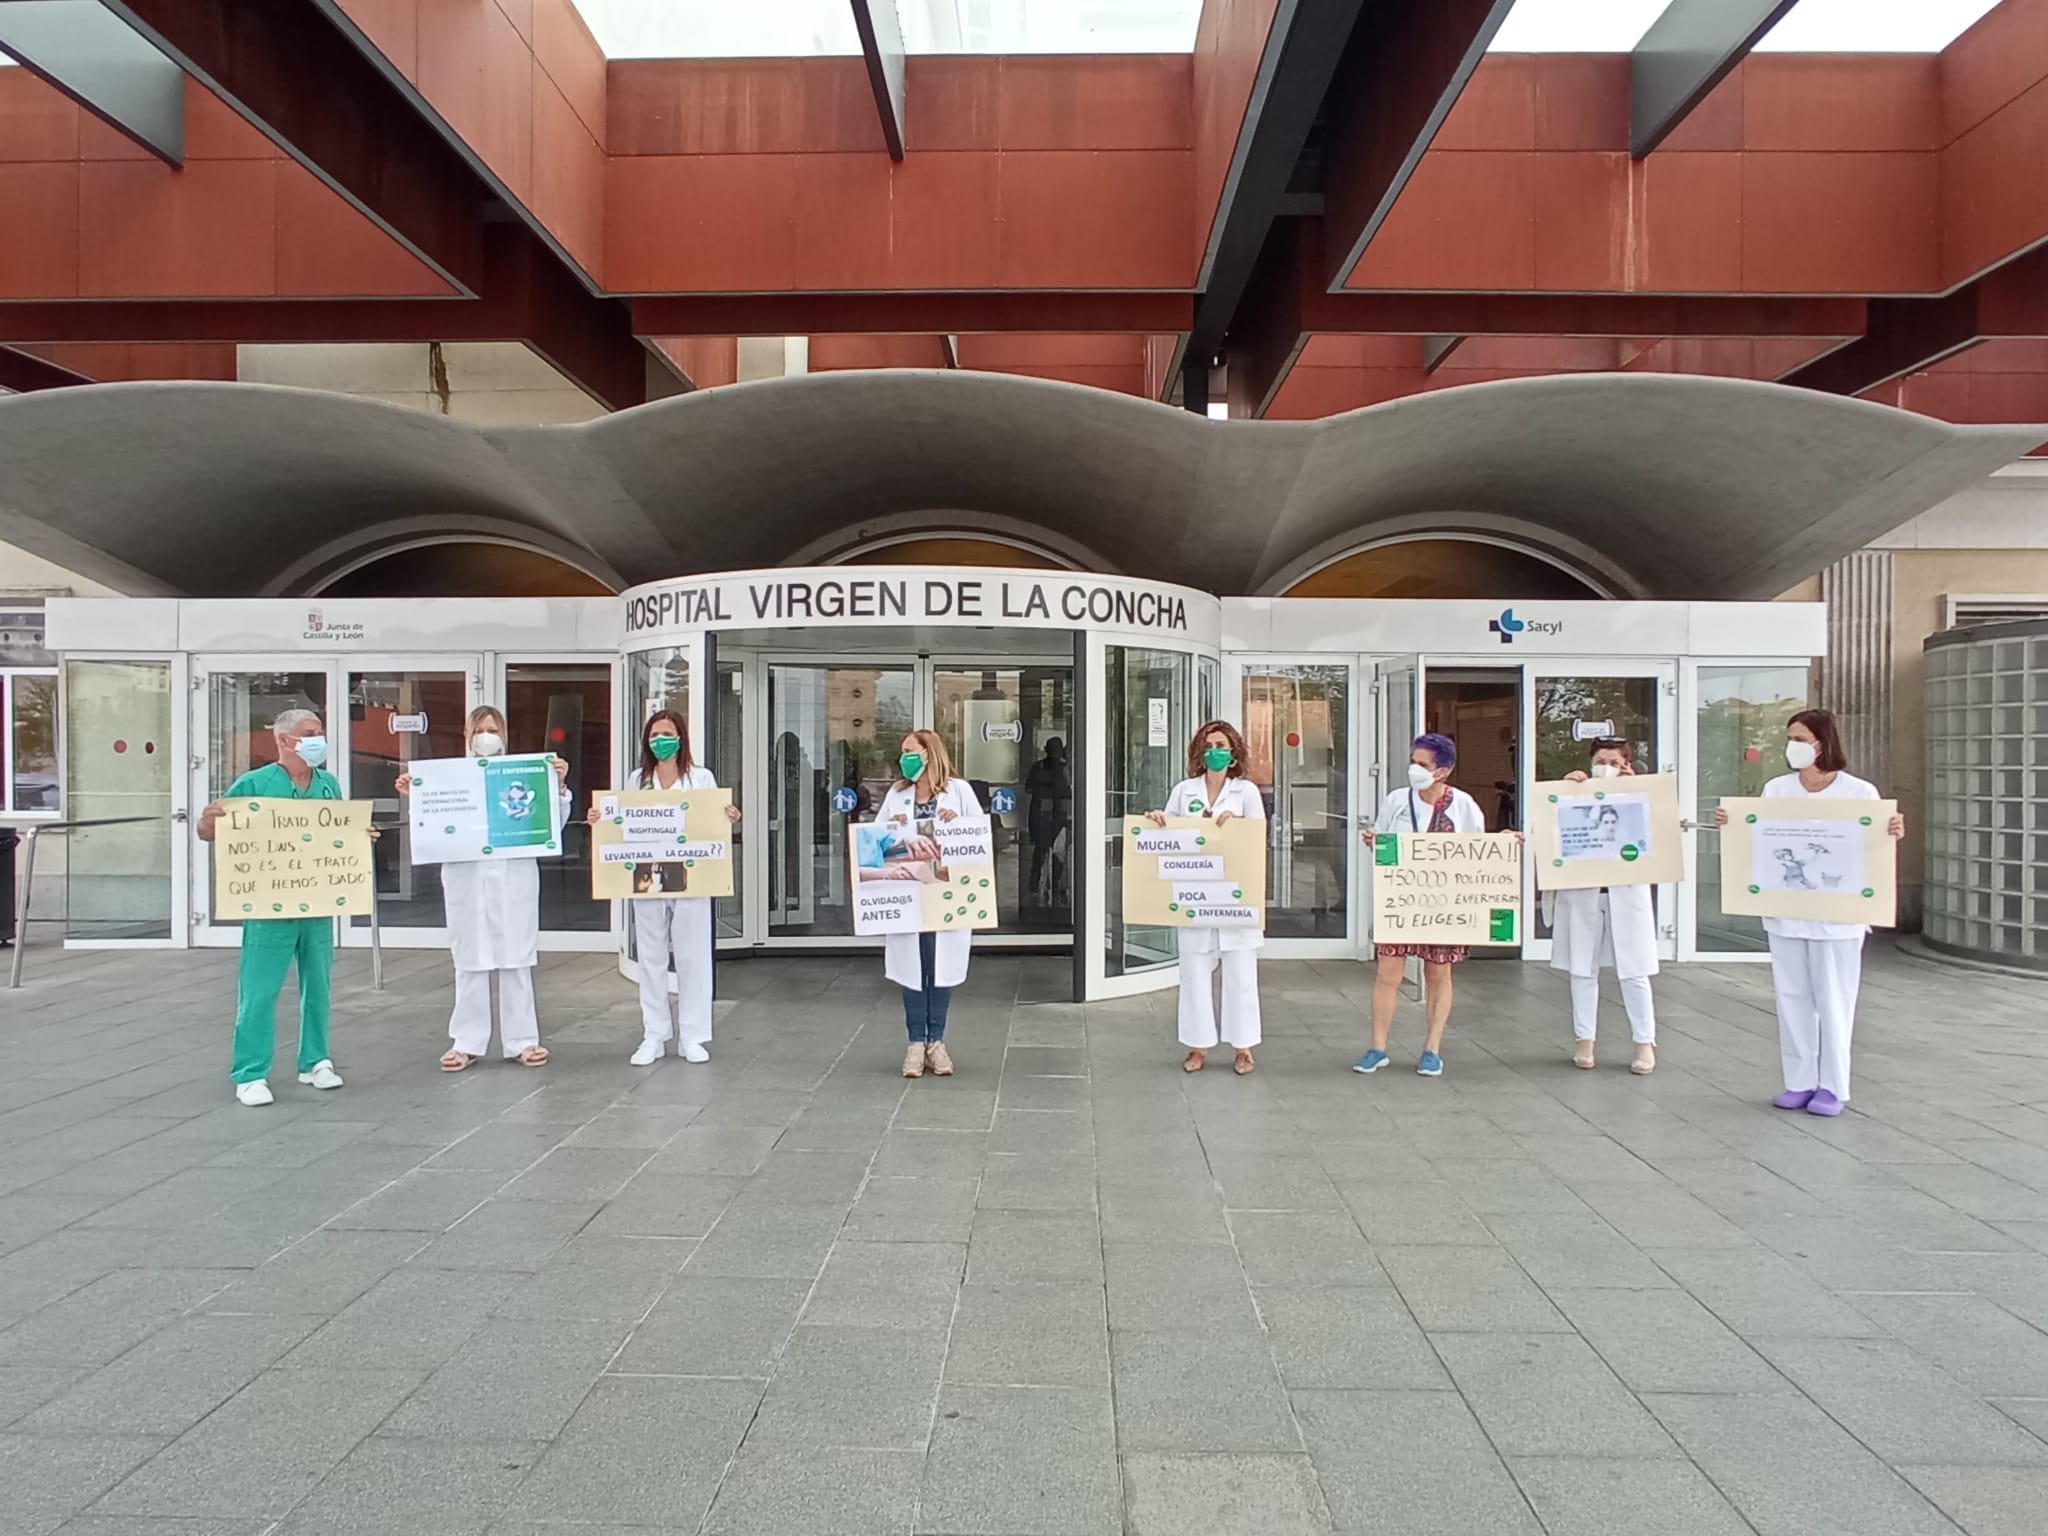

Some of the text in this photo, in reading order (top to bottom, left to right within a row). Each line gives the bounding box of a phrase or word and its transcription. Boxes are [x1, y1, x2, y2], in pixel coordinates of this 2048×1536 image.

[626, 581, 1187, 632] HOSPITAL VIRGEN DE LA CONCHA
[326, 623, 364, 632] Junta de
[1527, 620, 1562, 636] Sacyl
[303, 631, 364, 641] Castilla y León
[272, 809, 309, 829] TRATO
[318, 806, 352, 828] QUE
[605, 806, 675, 818] SI FLORENCE
[935, 826, 988, 837] OLVIDAD@S
[228, 840, 260, 855] NOS
[942, 845, 986, 857] AHORA
[1137, 840, 1181, 851] MUCHA
[605, 851, 653, 861] LEVANTARA
[665, 849, 676, 857] LA
[234, 855, 359, 874] NO ES EL TRATO
[1164, 859, 1213, 869] CONSEJERÍA
[229, 880, 257, 895] QUE
[271, 877, 319, 890] HEMOS
[860, 895, 913, 906] OLVIDAD@S
[1179, 892, 1206, 901] POCA
[862, 909, 901, 921] ANTES
[1198, 908, 1252, 918] ENFERMERÍA
[1384, 914, 1405, 928] TU
